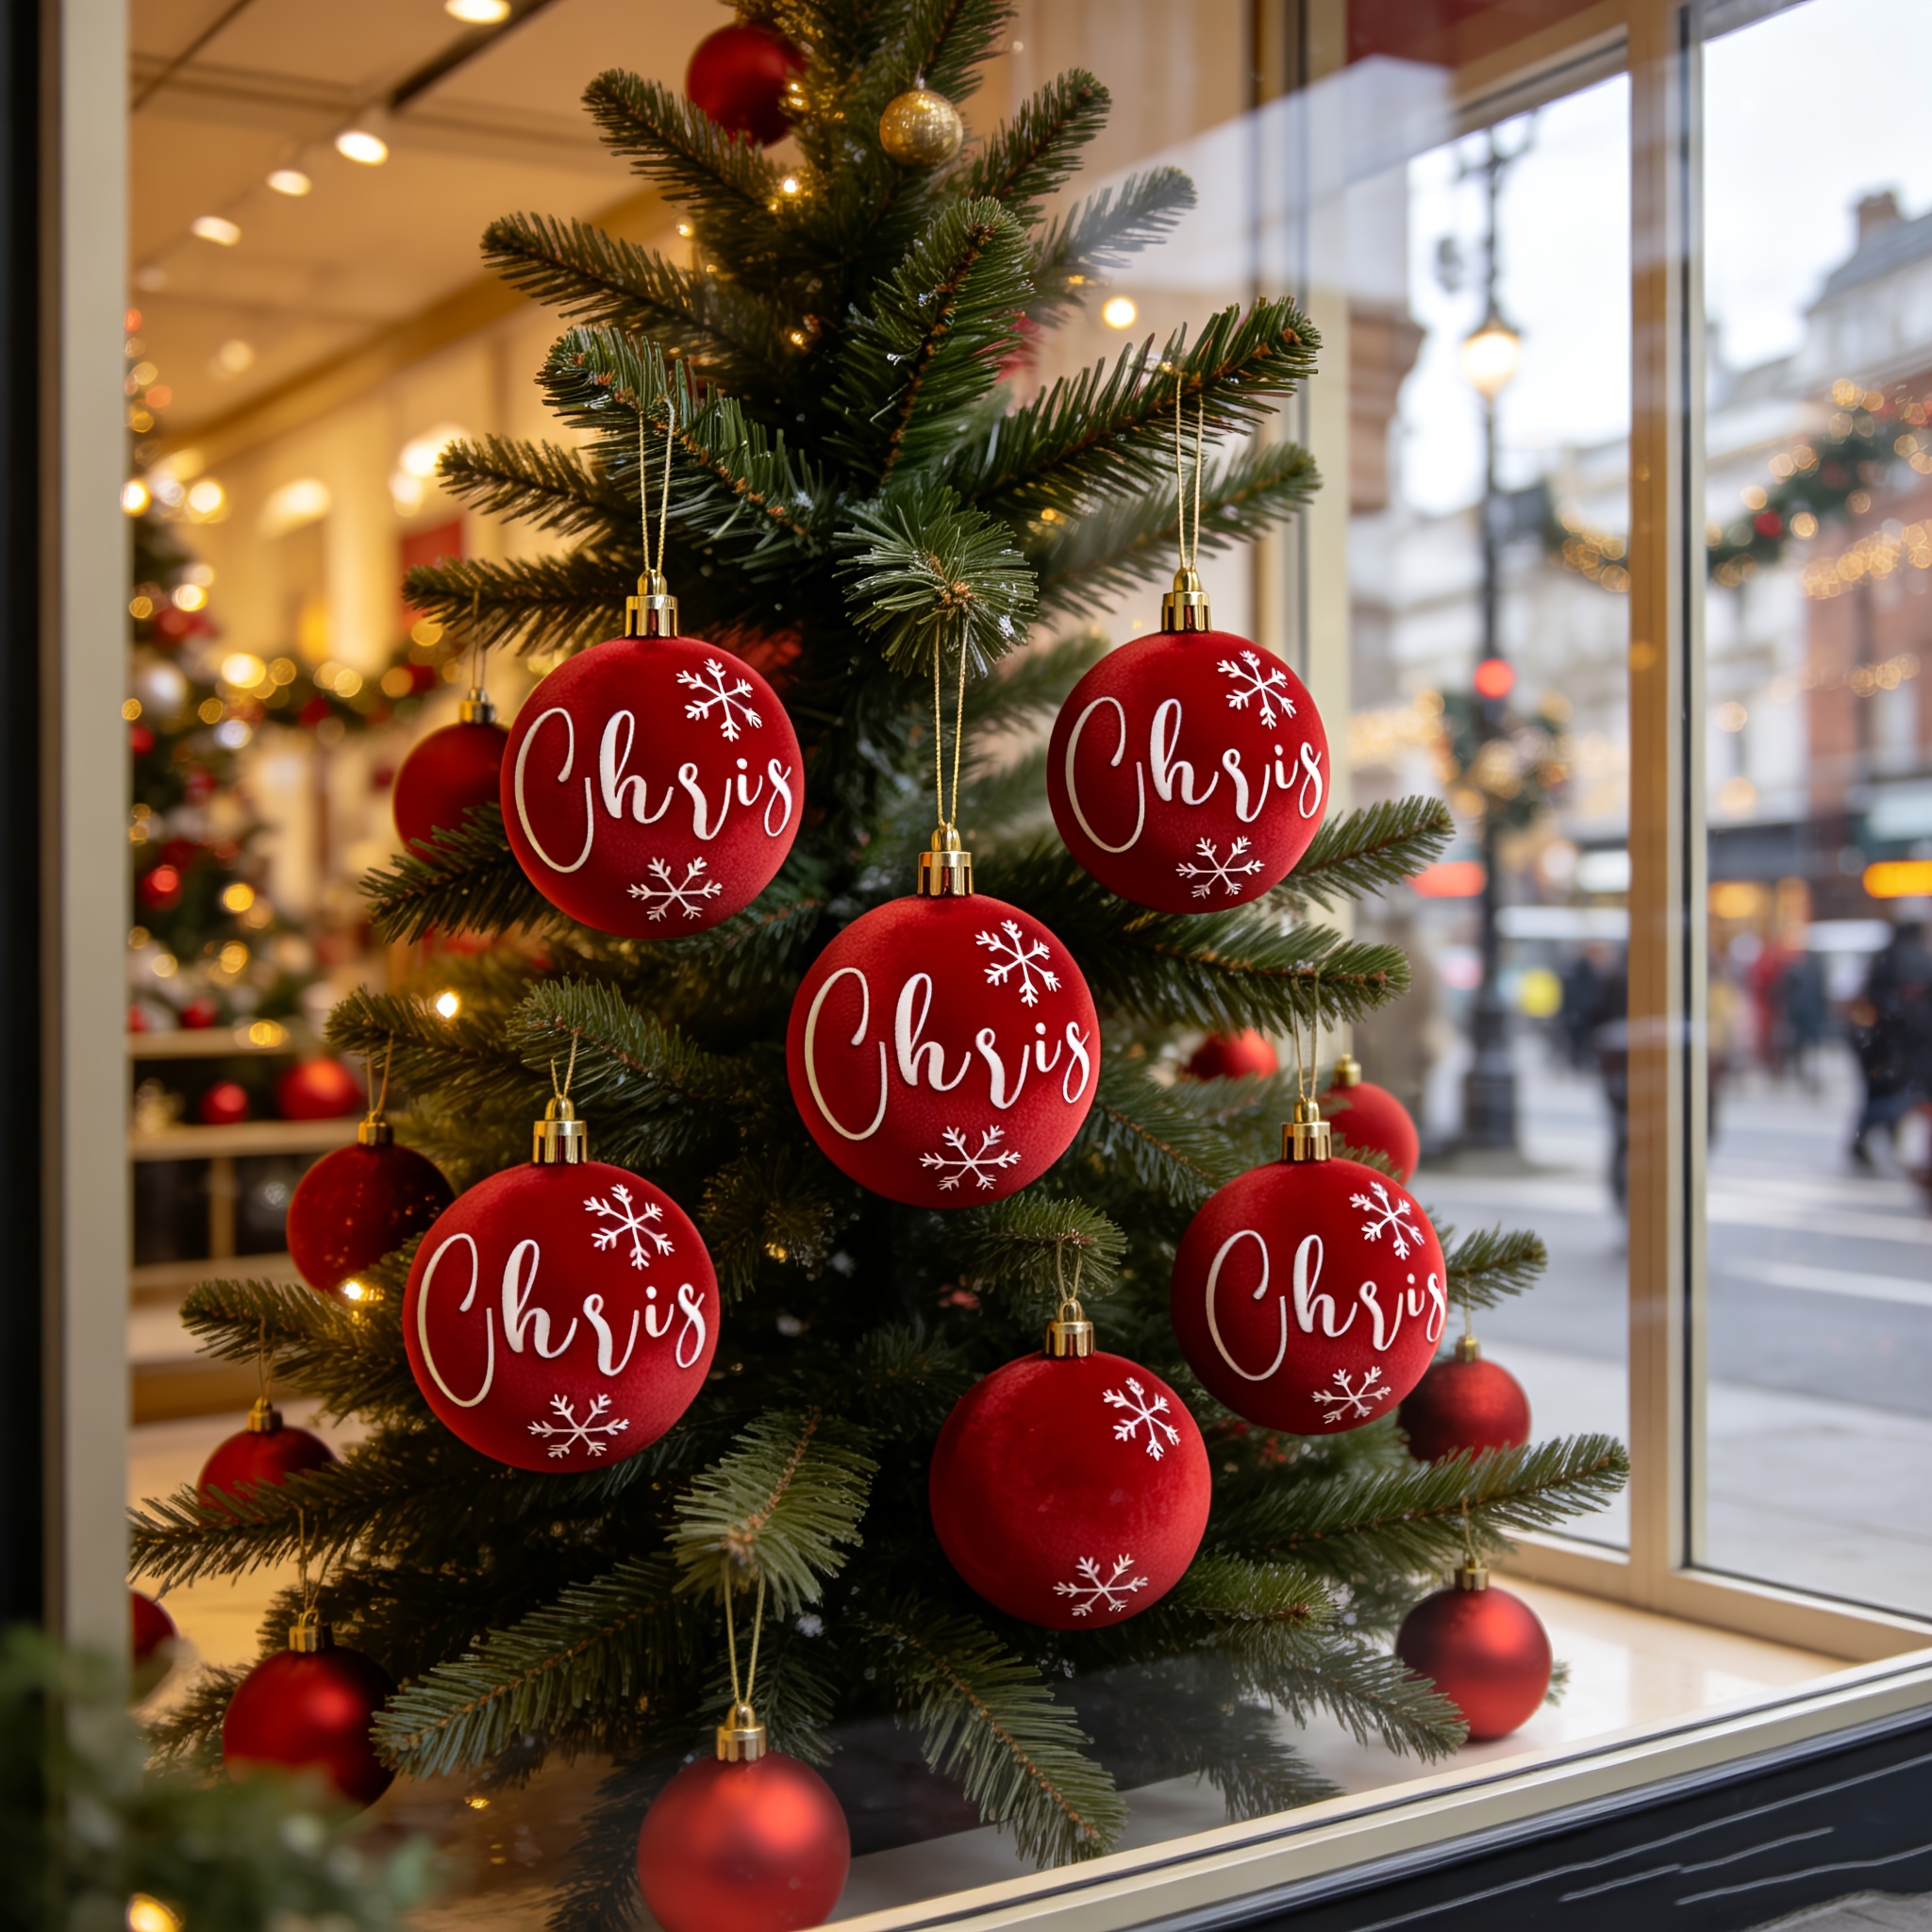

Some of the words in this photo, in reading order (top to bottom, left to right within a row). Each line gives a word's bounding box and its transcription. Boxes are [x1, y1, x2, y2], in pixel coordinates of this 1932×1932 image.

[514, 707, 793, 873] Chris
[1065, 696, 1324, 854] Chris
[802, 967, 1092, 1141] Chris
[417, 1232, 708, 1408] Chris
[1205, 1229, 1447, 1381] Chris
